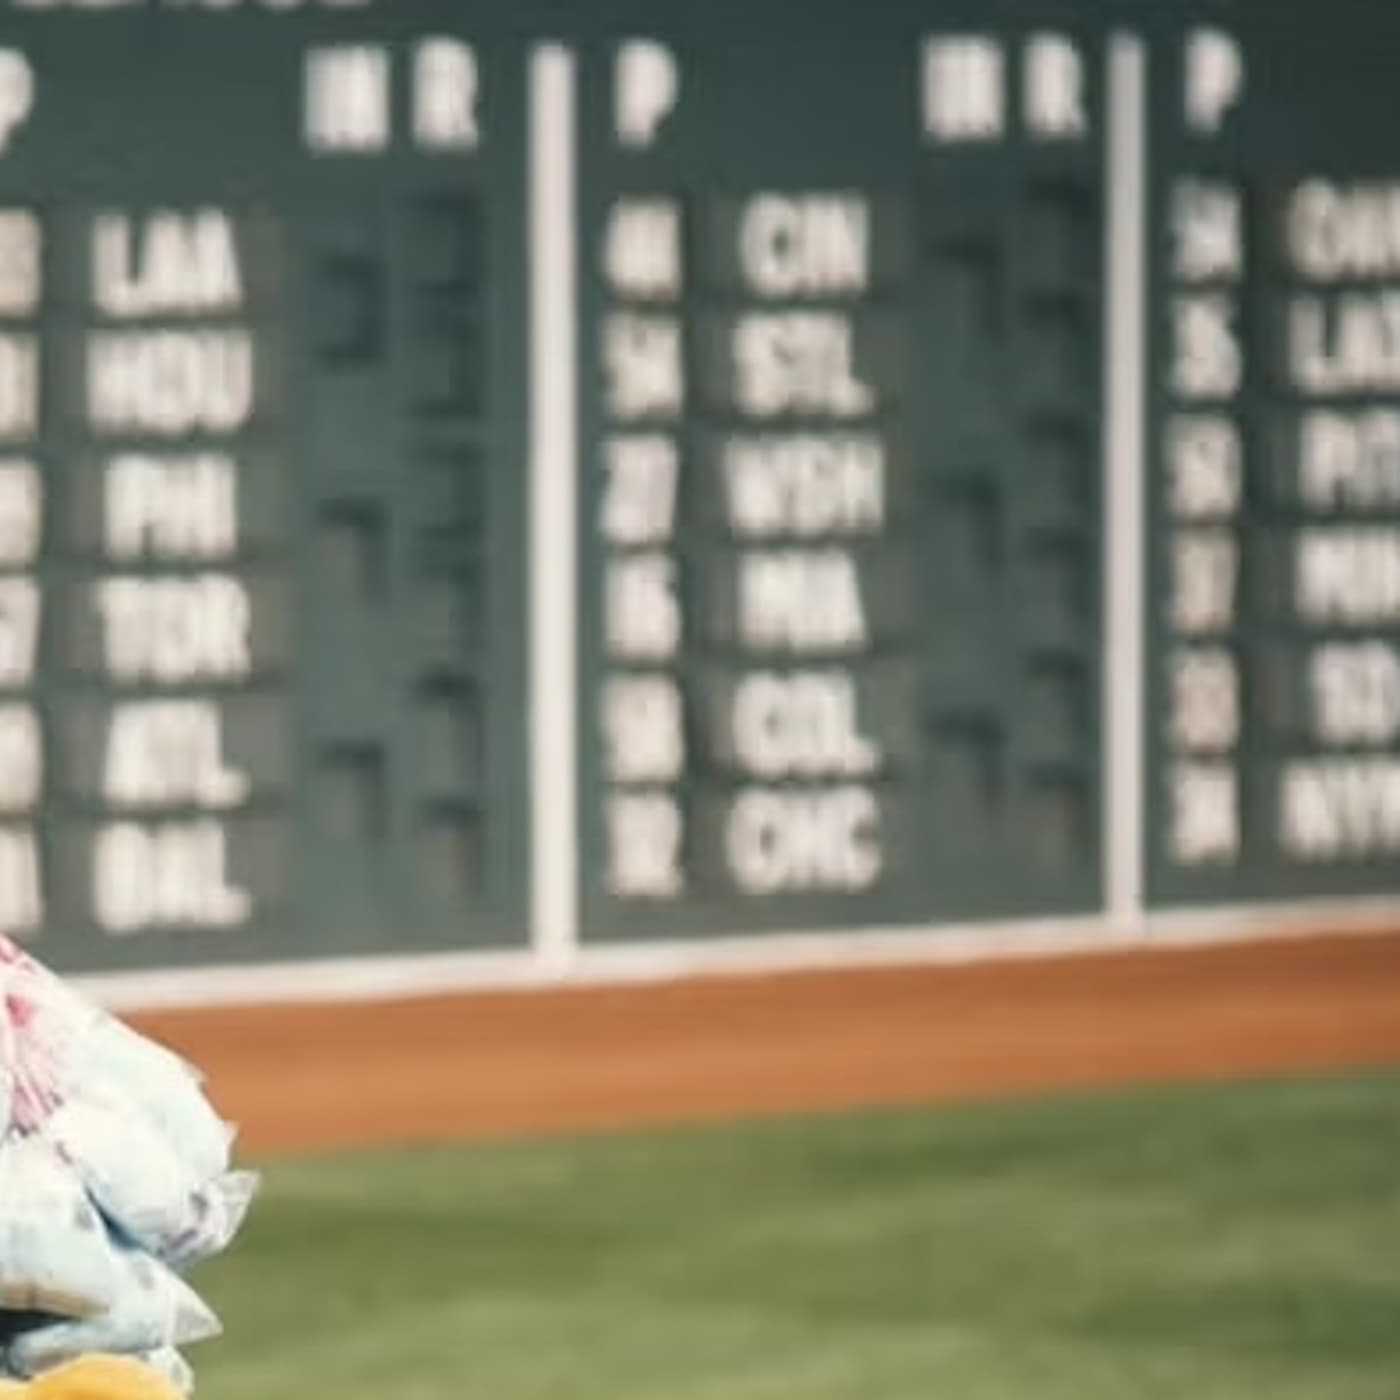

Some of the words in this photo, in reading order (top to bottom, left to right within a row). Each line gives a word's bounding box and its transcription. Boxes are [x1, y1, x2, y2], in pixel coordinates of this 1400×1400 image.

[412, 37, 480, 147] R
[615, 40, 678, 143] P
[1026, 35, 1084, 135] R
[1187, 31, 1241, 122] P
[90, 209, 244, 320] LAA
